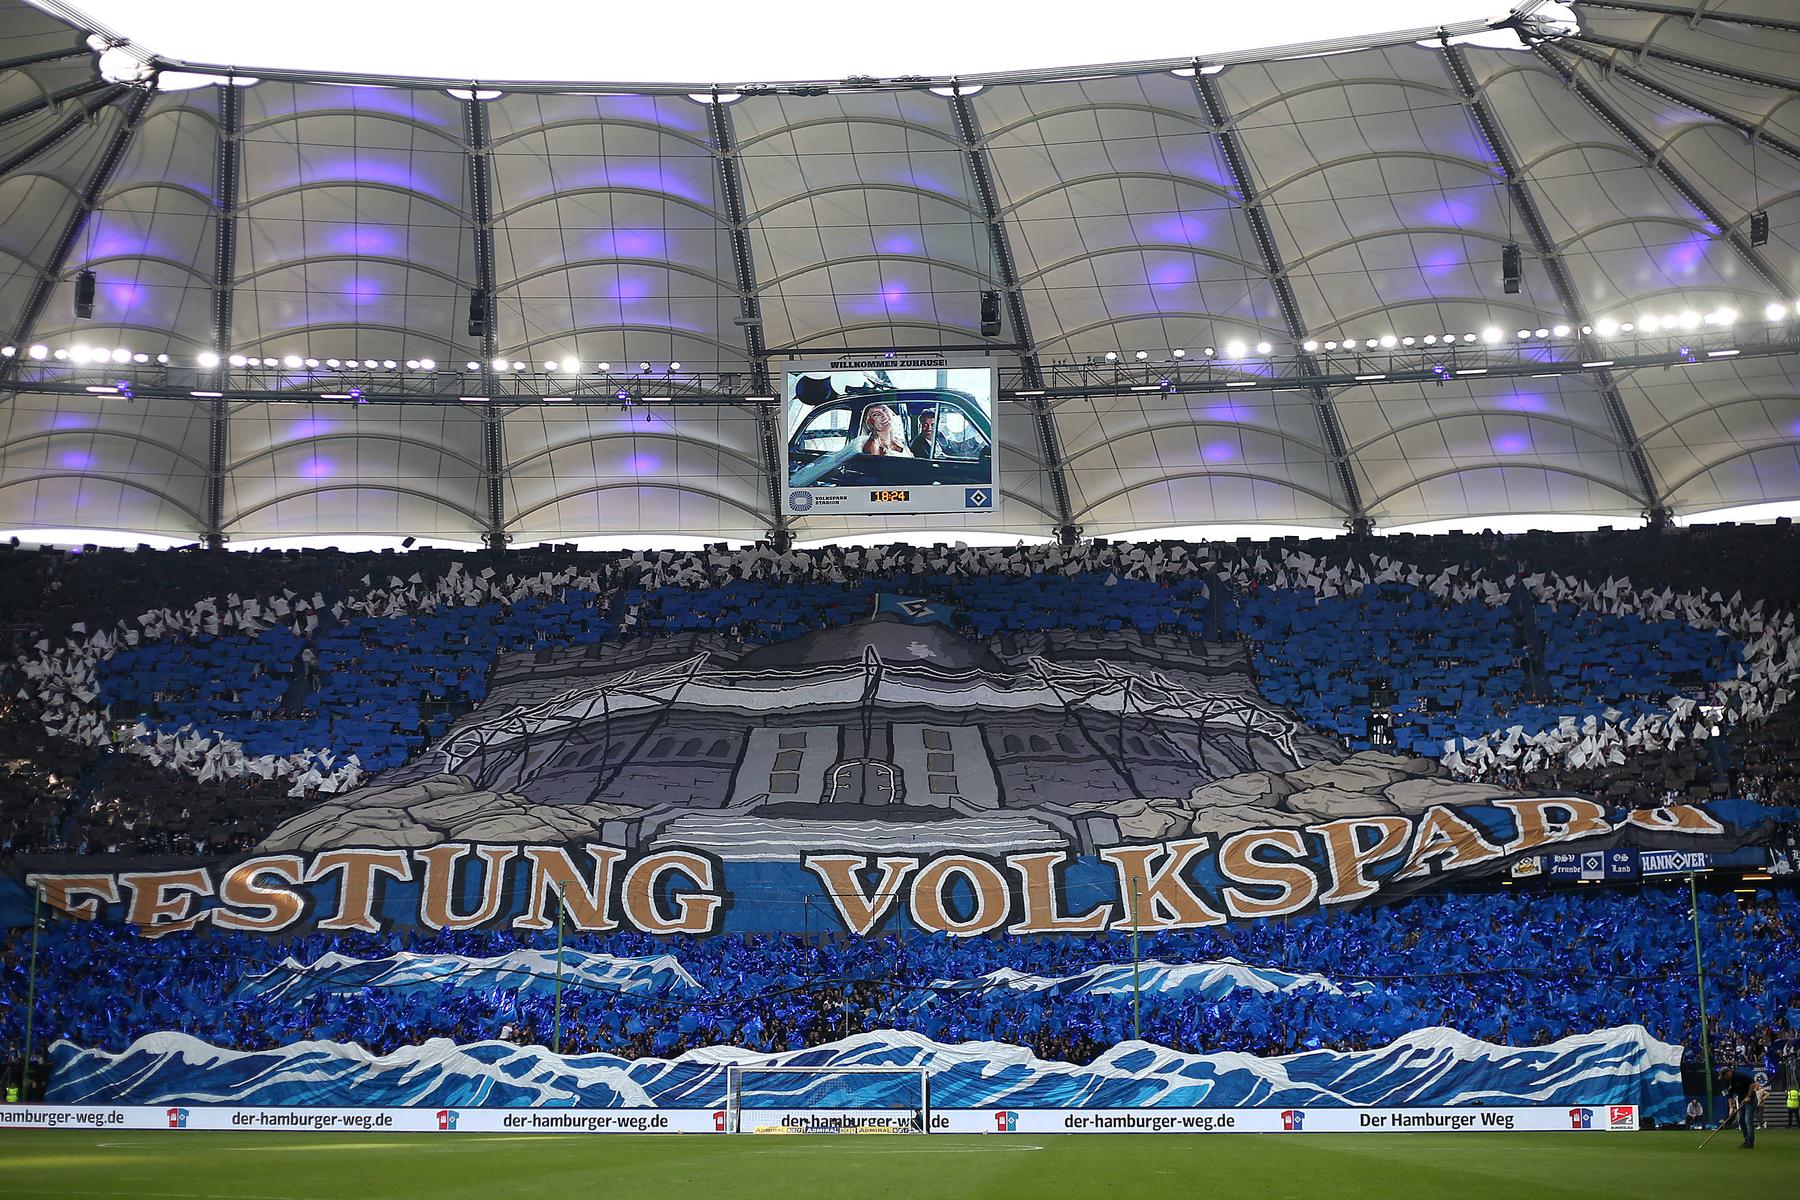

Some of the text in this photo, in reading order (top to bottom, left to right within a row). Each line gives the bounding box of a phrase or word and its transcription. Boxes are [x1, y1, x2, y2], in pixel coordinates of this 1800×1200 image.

[830, 359, 947, 369] WILLKOMMEN ZUHAUSE!
[875, 491, 905, 502] 18:24
[26, 842, 723, 938] FESTUNG
[232, 1111, 393, 1128] der-hamburger-weg.de
[503, 1113, 668, 1130] der-hamburger-weg.de
[1064, 1113, 1235, 1130] der-hamburger-weg.de
[1360, 1112, 1515, 1130] Der Hamburger Weg
